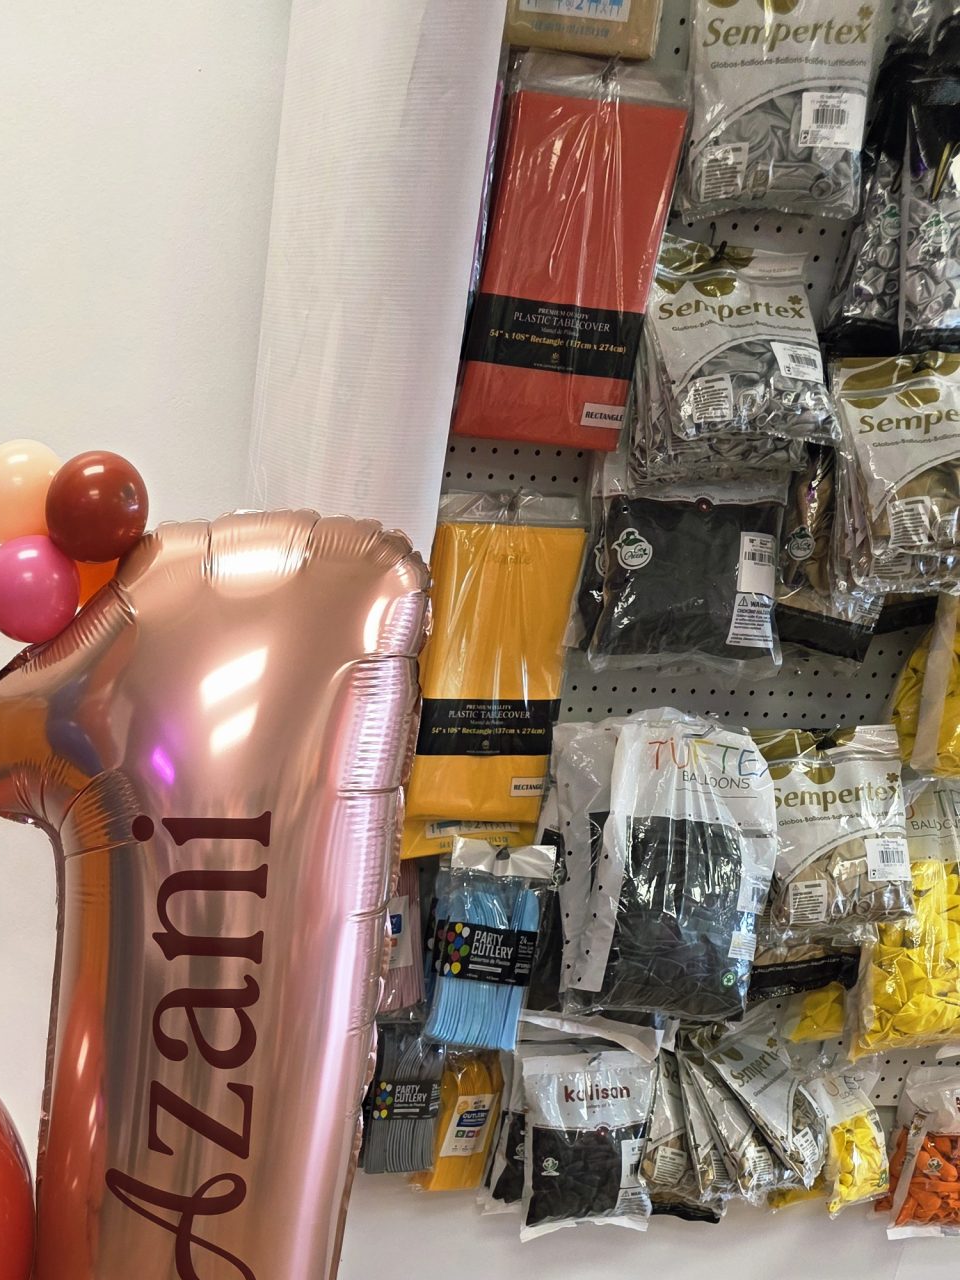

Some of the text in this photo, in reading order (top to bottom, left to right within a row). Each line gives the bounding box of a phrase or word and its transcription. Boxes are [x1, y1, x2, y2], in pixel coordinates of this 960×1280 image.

[703, 18, 872, 52] Sempertex
[513, 311, 551, 325] PLASTIC
[658, 299, 806, 322] Sempertex
[530, 335, 564, 347] Rectangle
[448, 710, 479, 719] PLASTIC
[461, 727, 492, 735] Rectangle
[648, 736, 768, 778] TUFTE
[682, 770, 751, 790] BALLOONS
[474, 930, 504, 947] PARTY
[471, 942, 514, 960] CUTLERY
[395, 1084, 421, 1095] PARTY
[394, 1092, 428, 1103] CUTLERY
